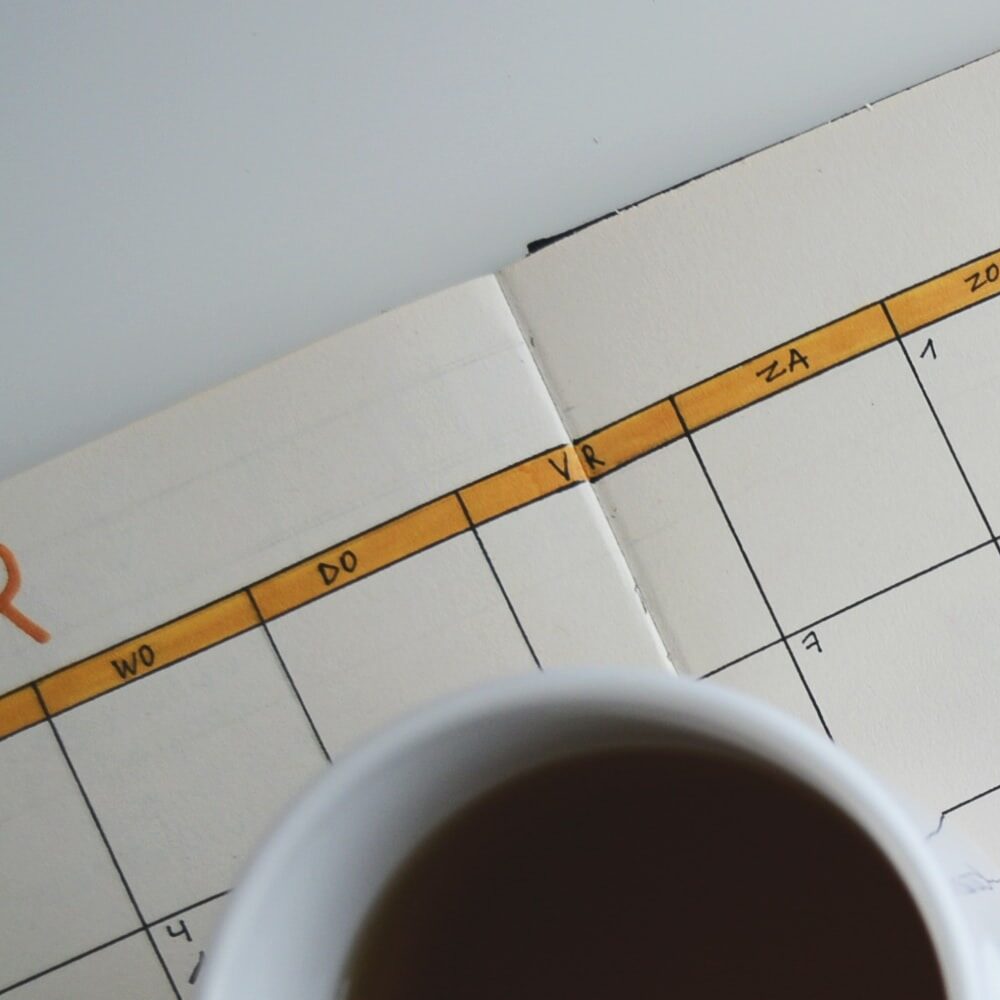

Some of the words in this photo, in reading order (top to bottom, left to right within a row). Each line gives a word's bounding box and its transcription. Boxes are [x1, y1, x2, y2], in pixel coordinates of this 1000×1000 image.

[964, 263, 1000, 293] ZO
[919, 338, 938, 361] 1
[756, 348, 810, 383] ZA
[317, 550, 359, 586] DO
[801, 631, 823, 653] 7
[111, 644, 156, 680] WO
[165, 919, 193, 943] 4
